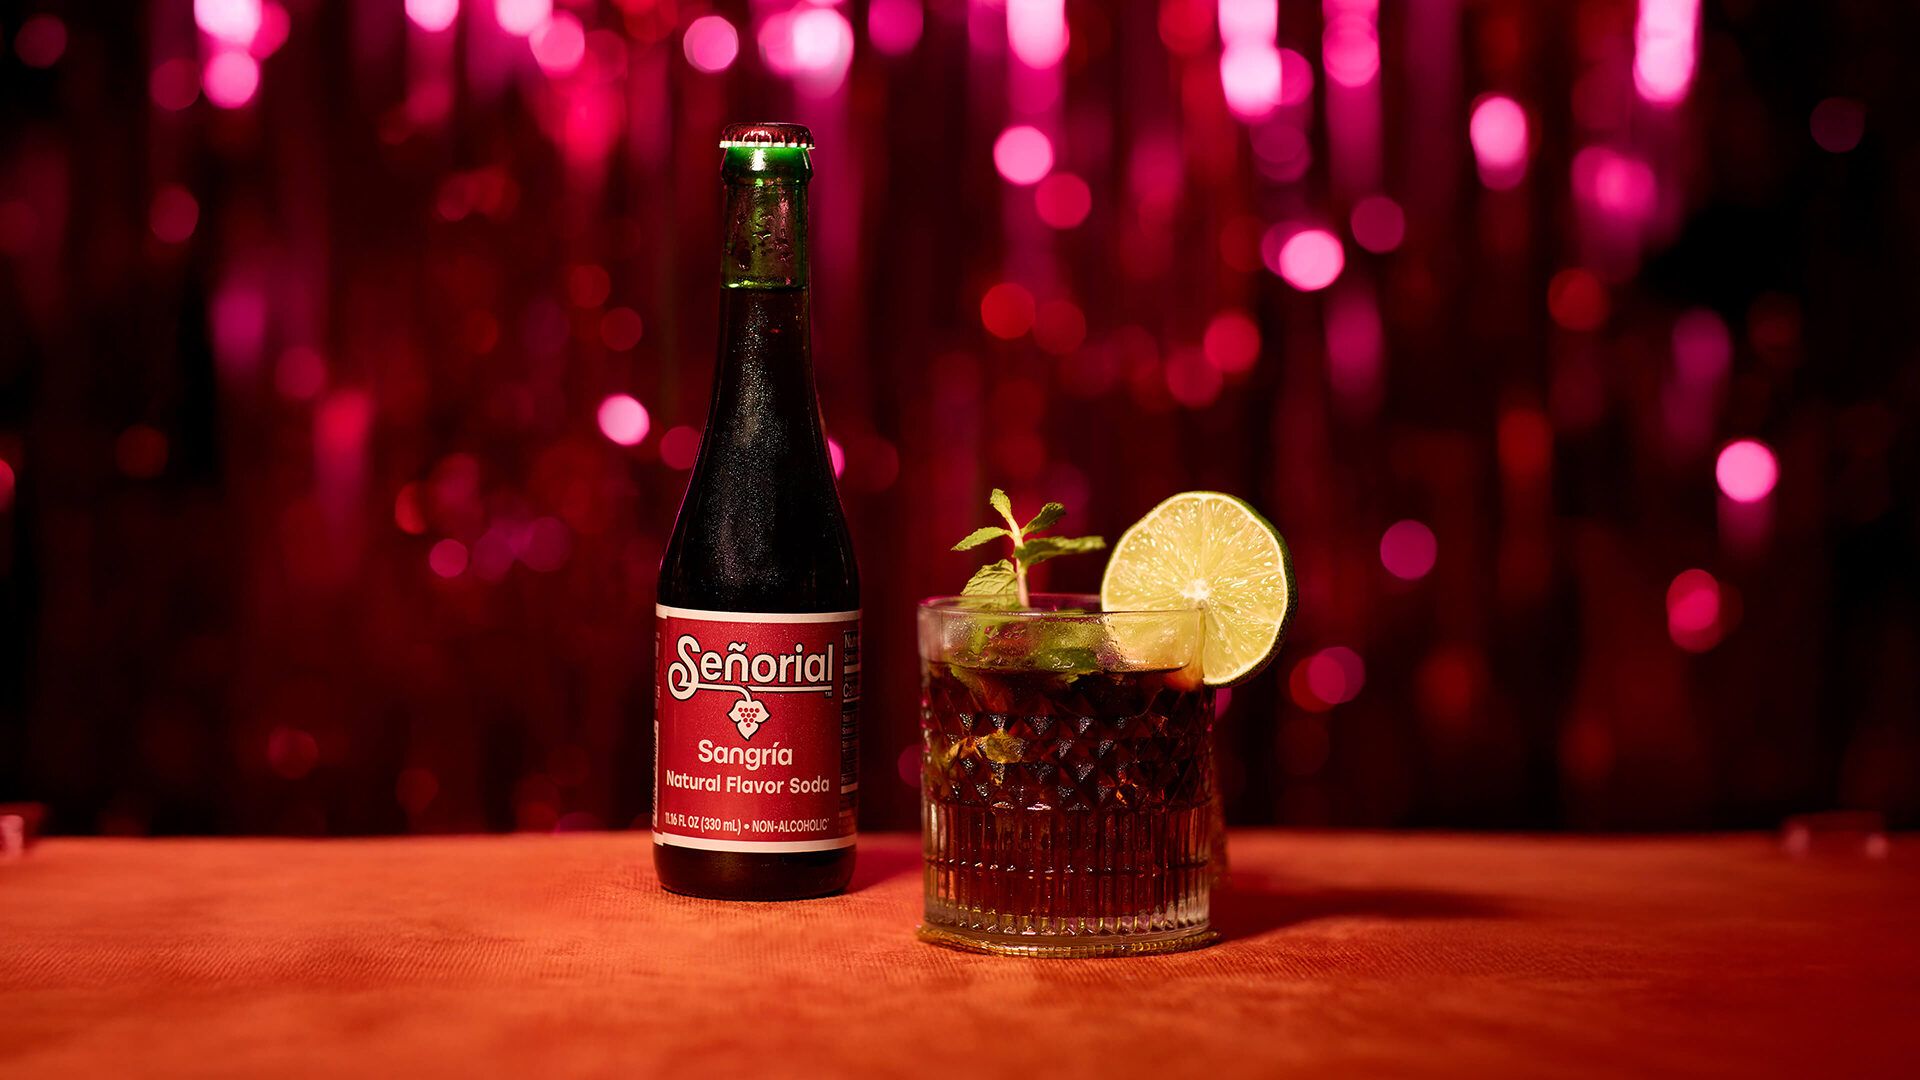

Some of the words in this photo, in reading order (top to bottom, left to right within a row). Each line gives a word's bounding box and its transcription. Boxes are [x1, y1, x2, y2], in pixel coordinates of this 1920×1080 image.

[667, 634, 834, 700] Señorial
[698, 739, 793, 771] Sangría
[666, 770, 721, 792] Natural
[726, 776, 785, 794] Flavor
[789, 775, 830, 794] Soda
[678, 814, 687, 827] FL
[687, 815, 700, 829] OZ
[701, 816, 722, 833] (330
[723, 818, 741, 836] mL)
